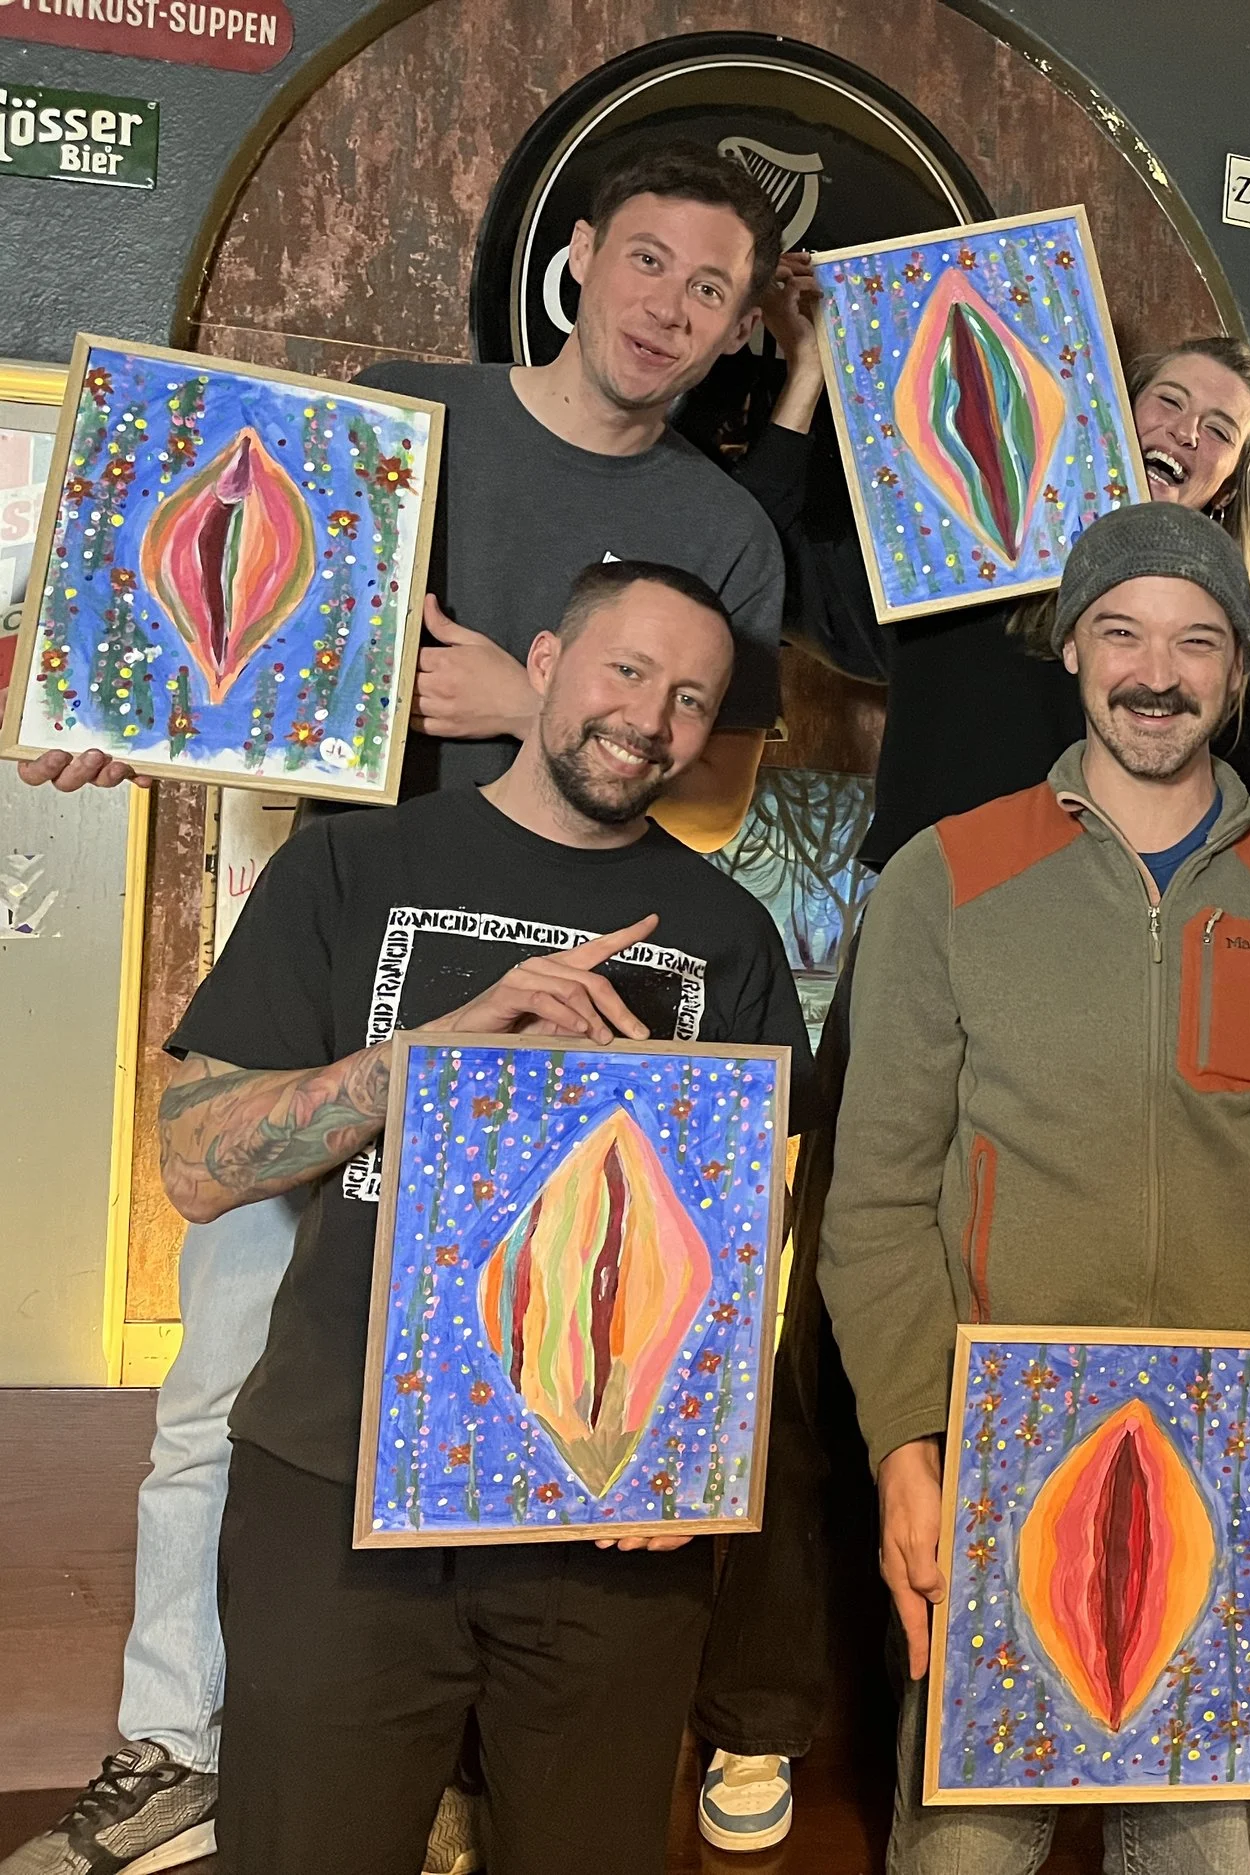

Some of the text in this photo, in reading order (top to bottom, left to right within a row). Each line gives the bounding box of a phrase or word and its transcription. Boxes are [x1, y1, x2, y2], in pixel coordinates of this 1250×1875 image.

[60, 143, 124, 175] Bier
[389, 910, 478, 933] RANCID
[483, 919, 569, 945] RANCID
[376, 930, 408, 997] RANCID
